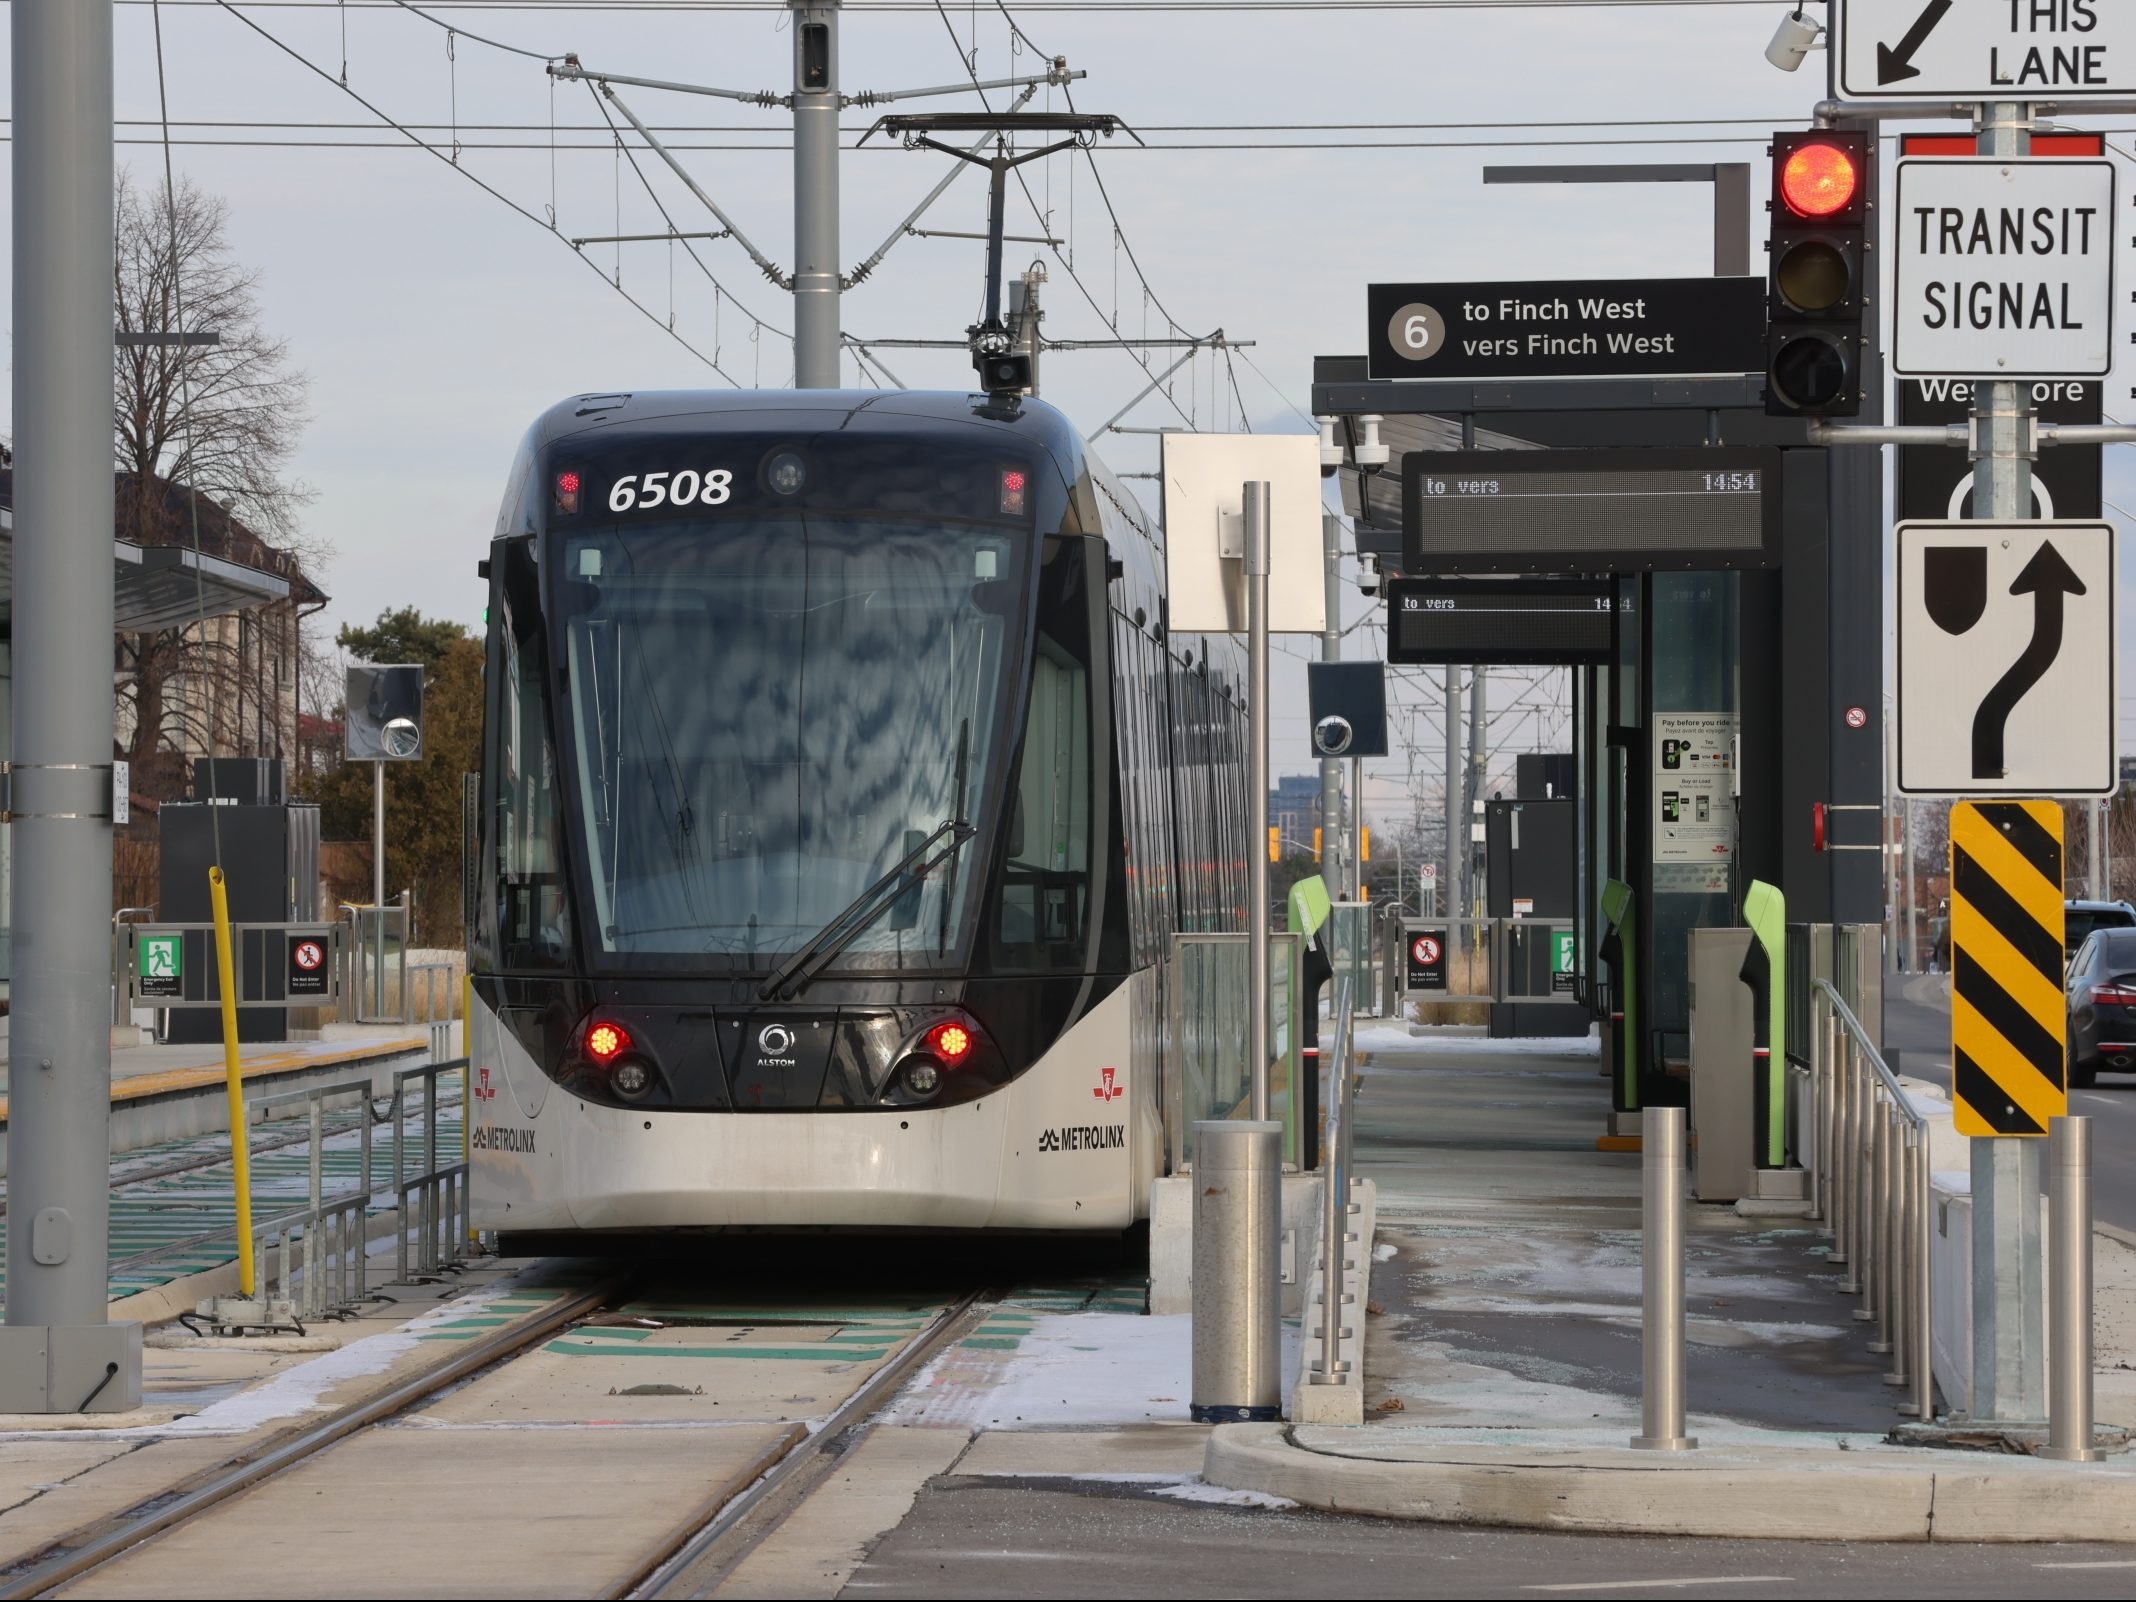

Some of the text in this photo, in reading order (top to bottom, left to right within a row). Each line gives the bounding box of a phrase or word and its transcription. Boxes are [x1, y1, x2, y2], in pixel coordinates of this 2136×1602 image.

[2003, 0, 2097, 32] THIS
[1990, 46, 2107, 85] LANE
[1914, 207, 2096, 255] TRANSIT
[1463, 298, 1646, 321] to Finch West
[1923, 281, 2083, 330] SIGNAL
[1404, 315, 1429, 349] 6
[1463, 332, 1675, 356] vers Finch West
[1919, 379, 2084, 402] Weore
[608, 469, 733, 512] 6508
[1427, 478, 1499, 495] to vers
[1702, 473, 1756, 490] 14:54
[1404, 597, 1455, 609] to vers
[1594, 597, 1632, 610] 144
[1662, 719, 1675, 727] Pay
[757, 1058, 796, 1067] ALSTOM
[487, 1126, 536, 1153] METROLINX
[1061, 1125, 1125, 1151] METROLINX
